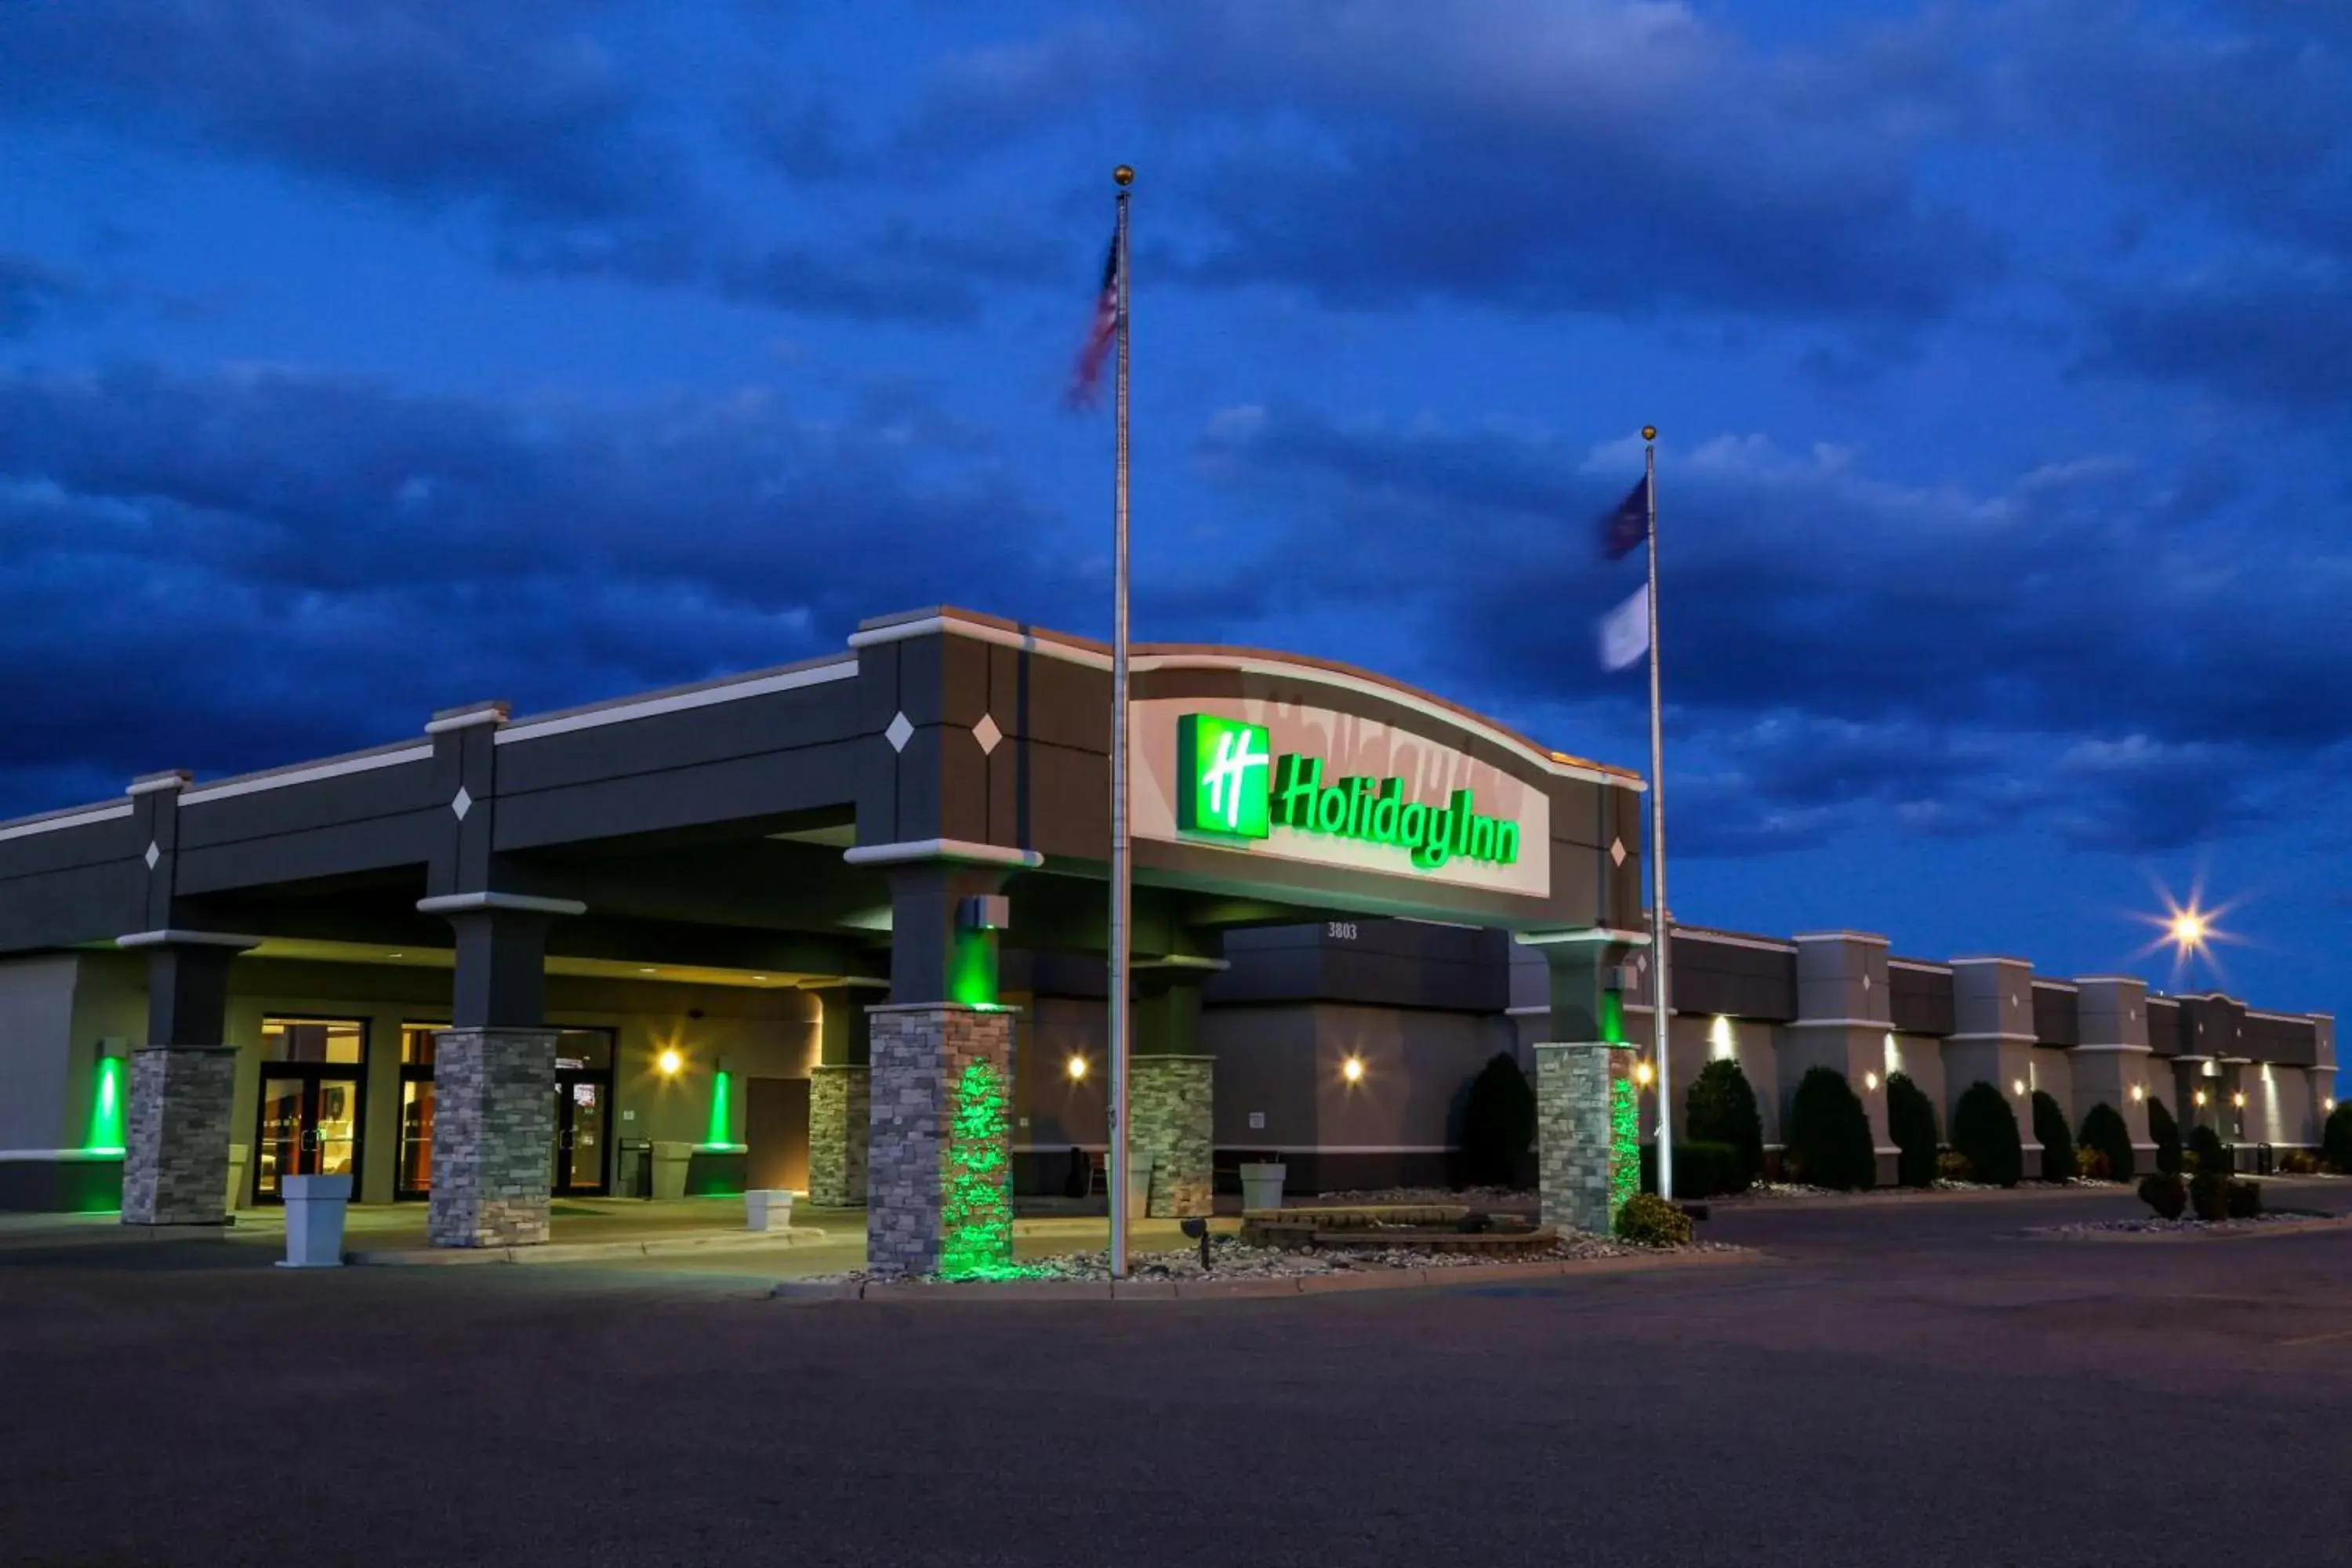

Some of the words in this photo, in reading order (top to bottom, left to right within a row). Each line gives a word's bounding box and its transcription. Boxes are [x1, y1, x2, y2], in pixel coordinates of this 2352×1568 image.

[1272, 753, 1452, 868] Holiday
[1453, 789, 1519, 864] Inn
[1328, 921, 1357, 939] 3803
